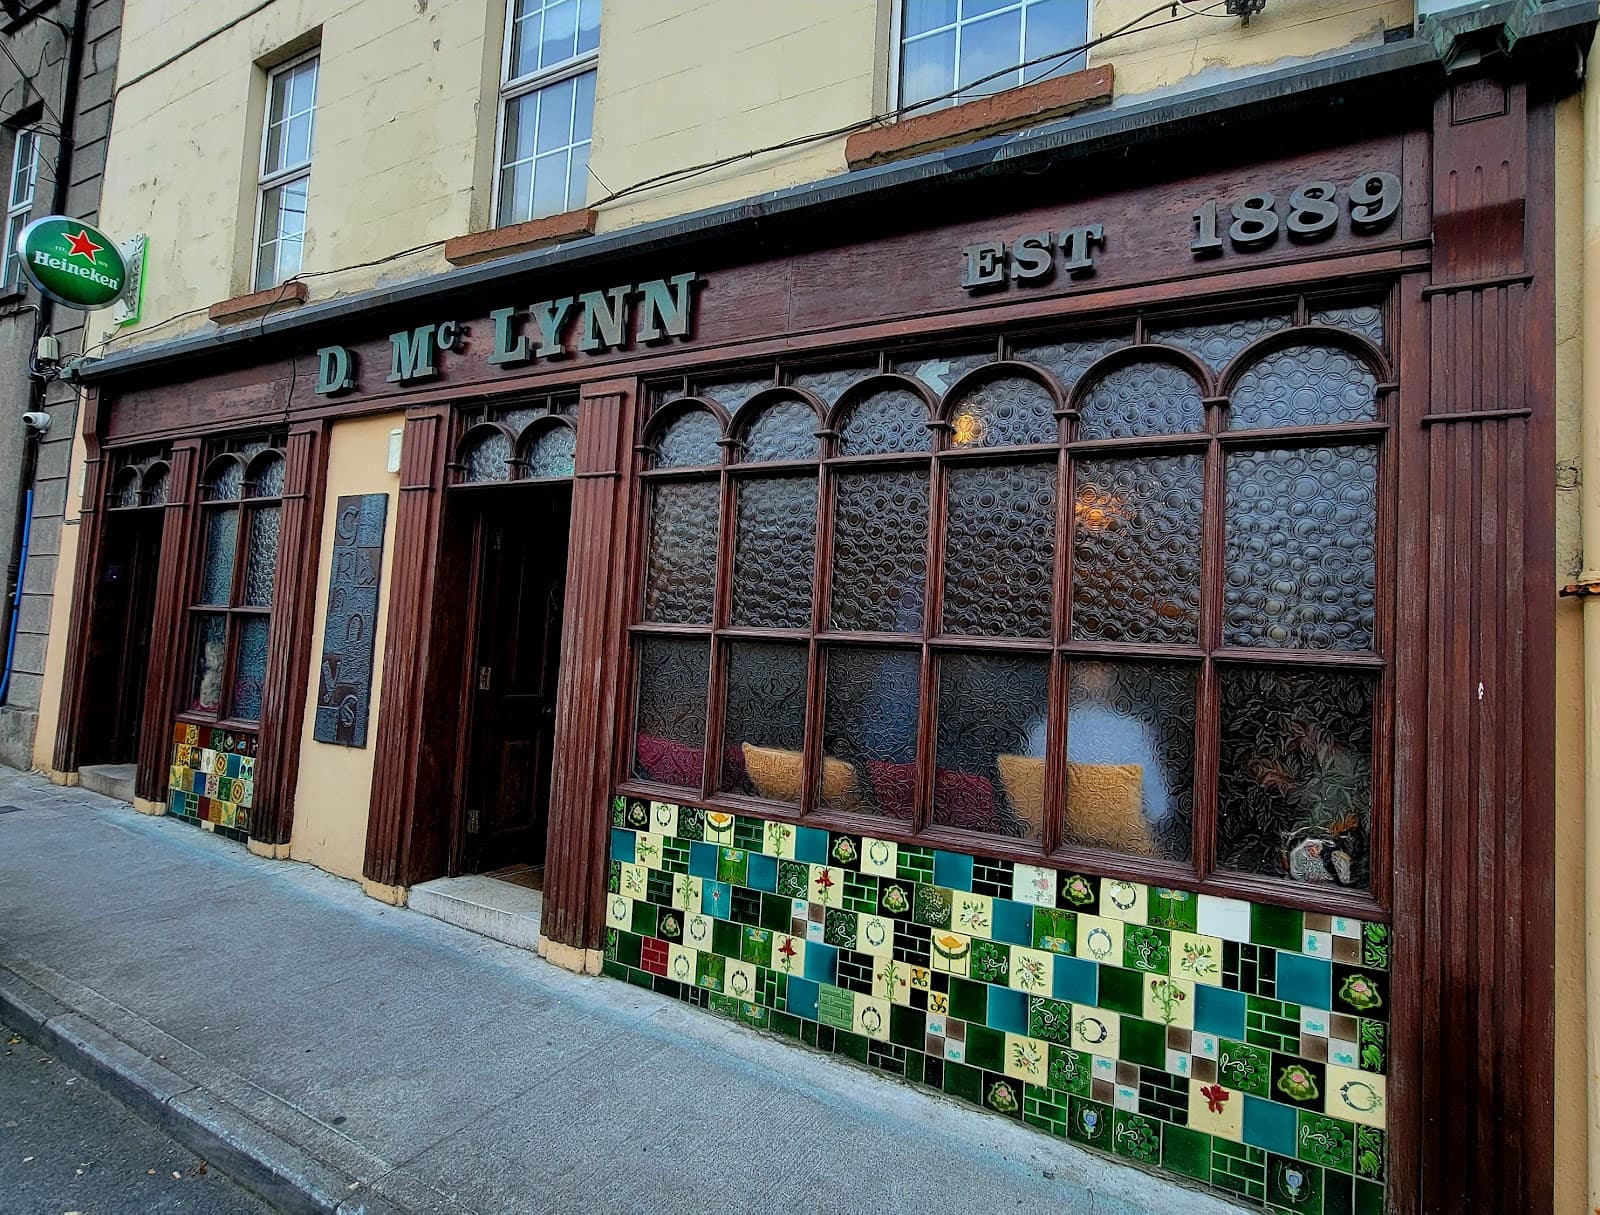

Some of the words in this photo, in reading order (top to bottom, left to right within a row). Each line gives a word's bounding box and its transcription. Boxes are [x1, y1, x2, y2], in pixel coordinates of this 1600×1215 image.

[1190, 171, 1402, 253] 1889
[33, 250, 119, 290] Heineken
[960, 222, 1104, 290] EST
[314, 344, 354, 395] D.
[487, 271, 697, 365] LYNN
